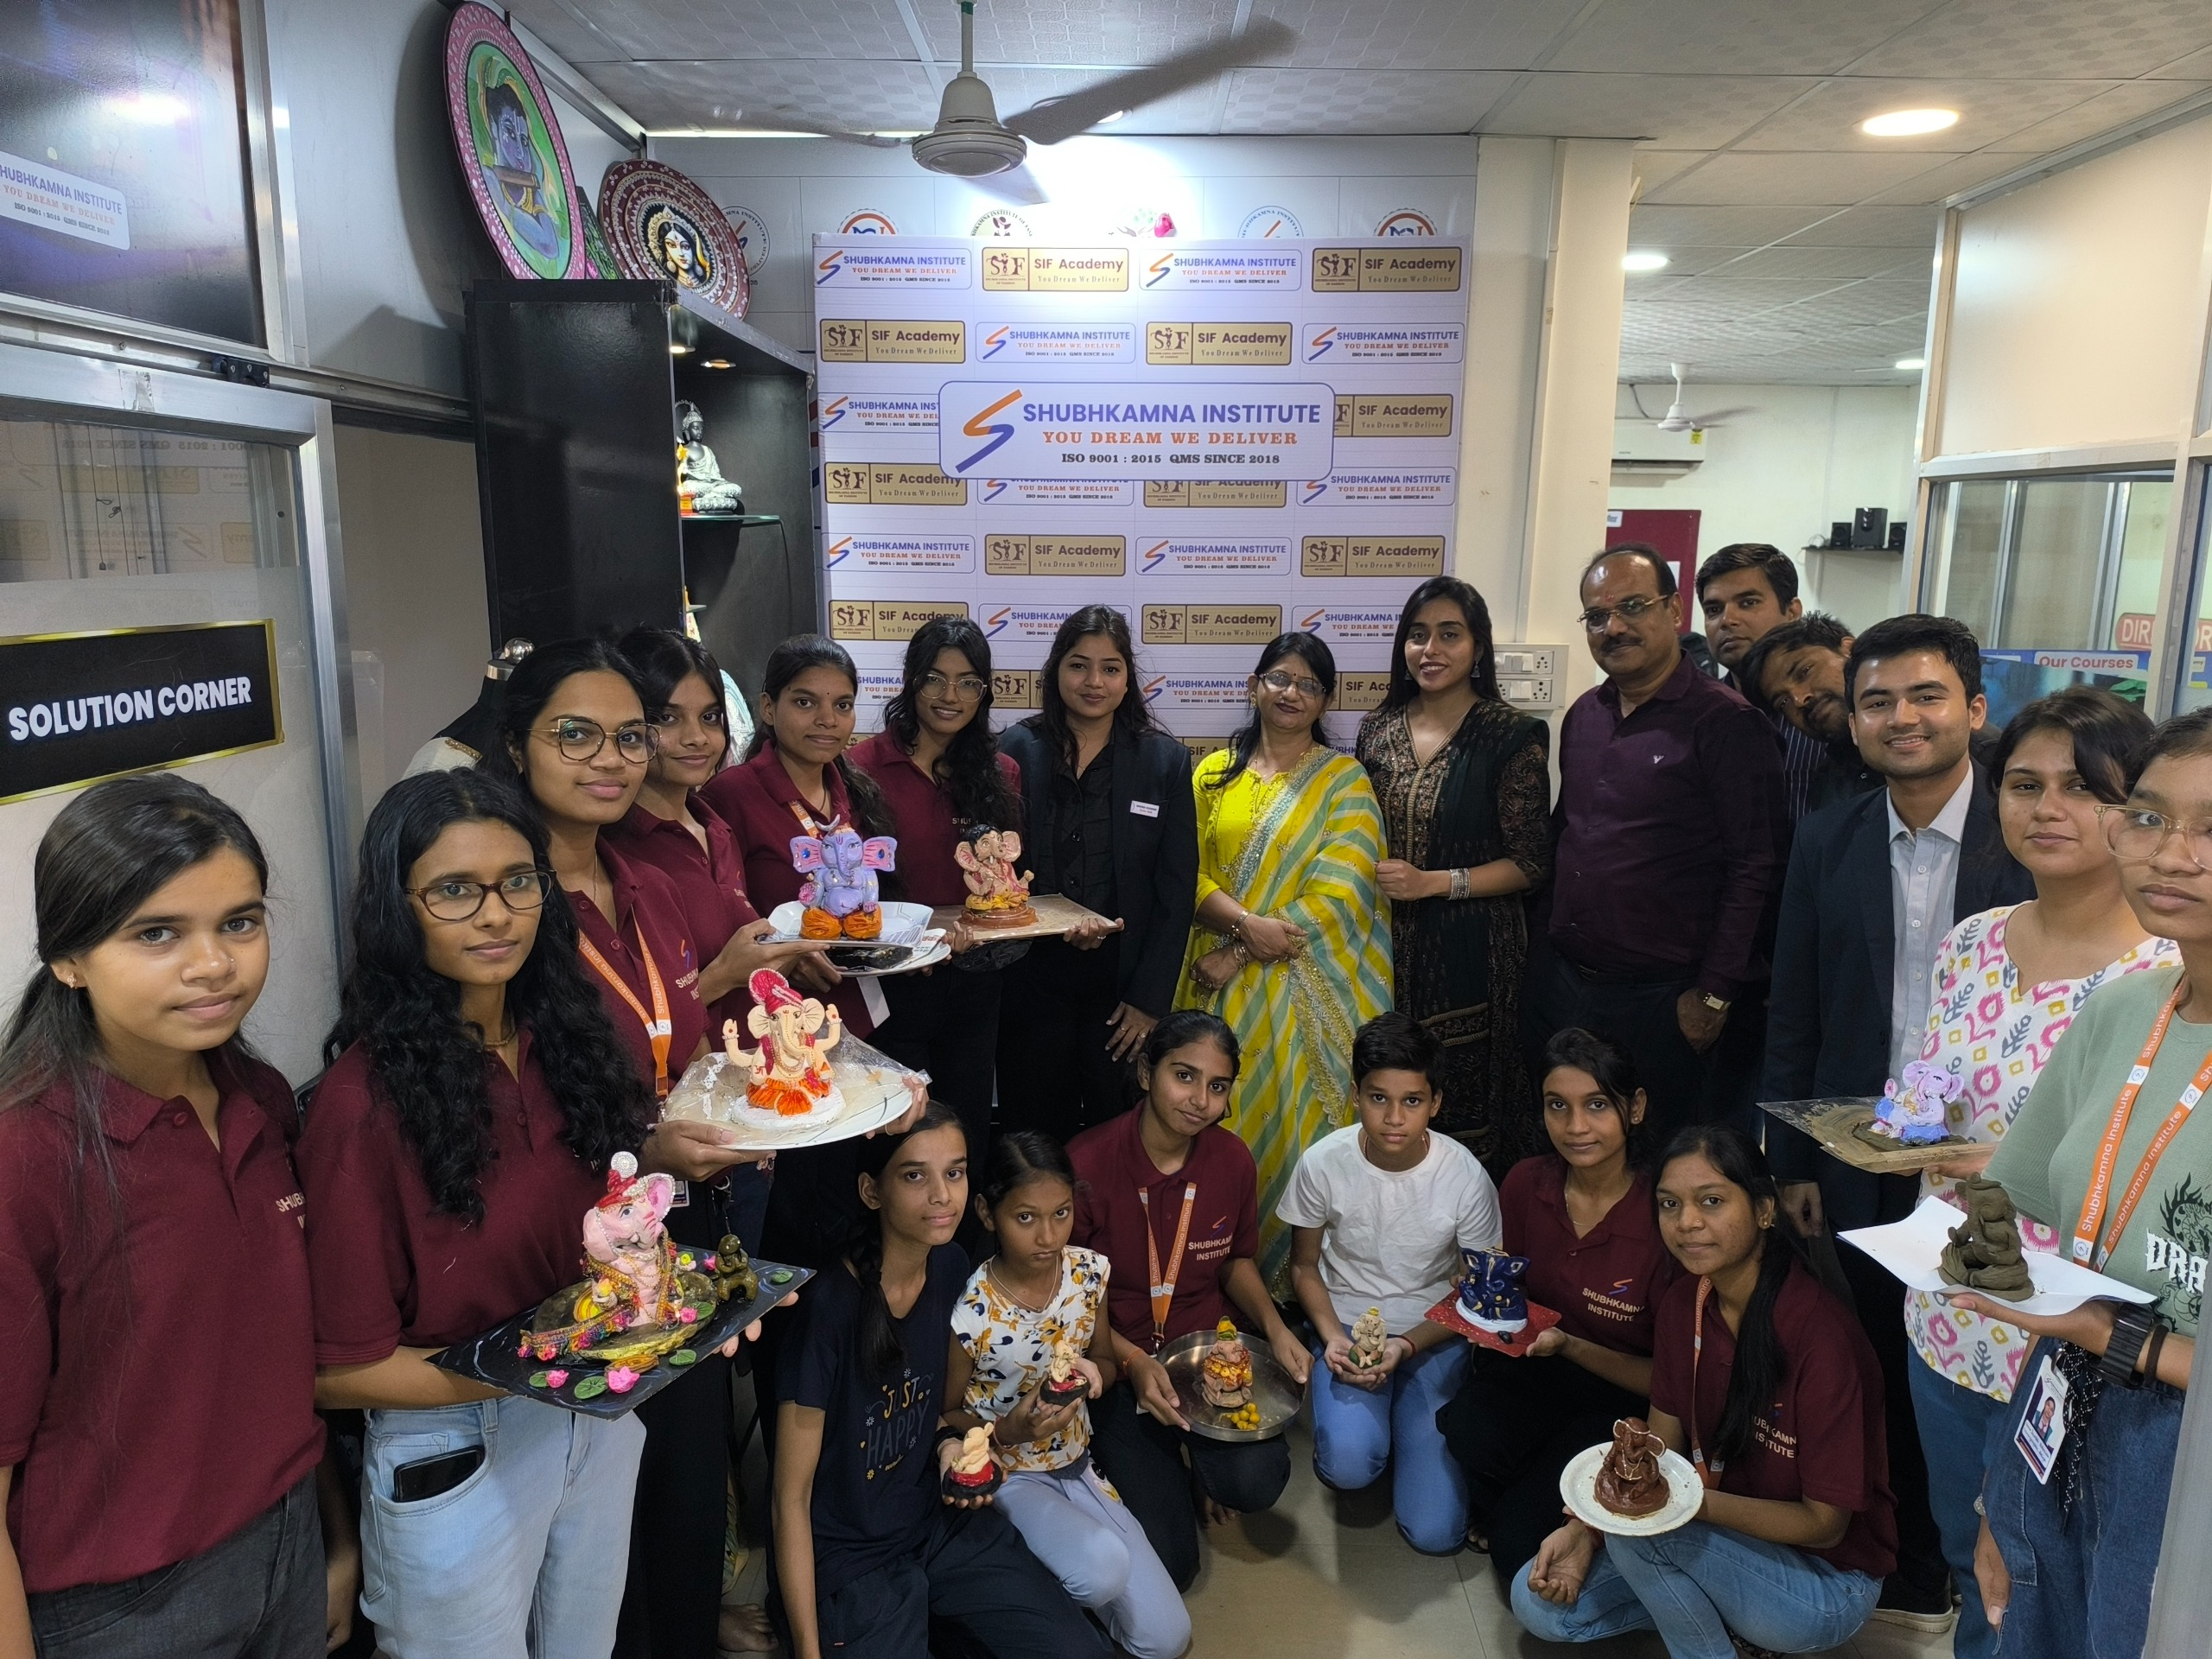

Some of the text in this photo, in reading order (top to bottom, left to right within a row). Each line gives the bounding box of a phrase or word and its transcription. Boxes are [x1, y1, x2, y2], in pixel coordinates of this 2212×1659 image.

[0, 165, 123, 214] HUBHKAMNA INSTITUTE
[3, 185, 115, 225] YOU DREAM WE DELIVER
[844, 256, 965, 265] SHUBHKAMNA INSTITUTE
[1034, 258, 1123, 272] SIF Academy
[1365, 258, 1455, 272] SIF Academy
[872, 330, 960, 345] SIF Academy
[1010, 331, 1079, 340] SHUBHKAMNA
[1198, 333, 1287, 346] SIF Academy
[1337, 332, 1408, 340] SHUBHKAMNA
[1023, 404, 1320, 423] SHUBHKAMNA INSTITUTE
[1359, 405, 1447, 418] SIF Academy
[1043, 431, 1297, 444] YOU DREAM WE DELIVER
[1061, 453, 1085, 464] ISO
[1089, 454, 1119, 464] 9001
[1131, 454, 1161, 464] 2015
[1169, 454, 1200, 464] QMS
[1205, 454, 1245, 464] SINCE
[1249, 454, 1281, 465] 2018
[875, 474, 893, 483] SIF
[1332, 475, 1400, 484] SHUBHKAMNA
[853, 542, 969, 551] SHUBHKAMNA INSTITUTE
[1035, 545, 1121, 558] SIF Academy
[1352, 546, 1440, 558] SIF Academy
[880, 611, 897, 620] SIF
[1192, 614, 1277, 627] SIF Academy
[2121, 619, 2154, 644] DIR
[2039, 655, 2134, 670] Our Courses
[1346, 682, 1363, 690] SIF
[9, 676, 251, 741] SOLUTION CORNER
[1190, 747, 1206, 755] SIF
[2082, 1089, 2133, 1232] Shubhkamna Institute
[2108, 1110, 2182, 1244] Shubhkamna Institute
[1168, 1203, 1191, 1280] Shubhkamna Institute
[1588, 1303, 1634, 1322] INSTITUTE
[884, 1376, 919, 1418] JUST
[867, 1400, 930, 1468] HAPPY
